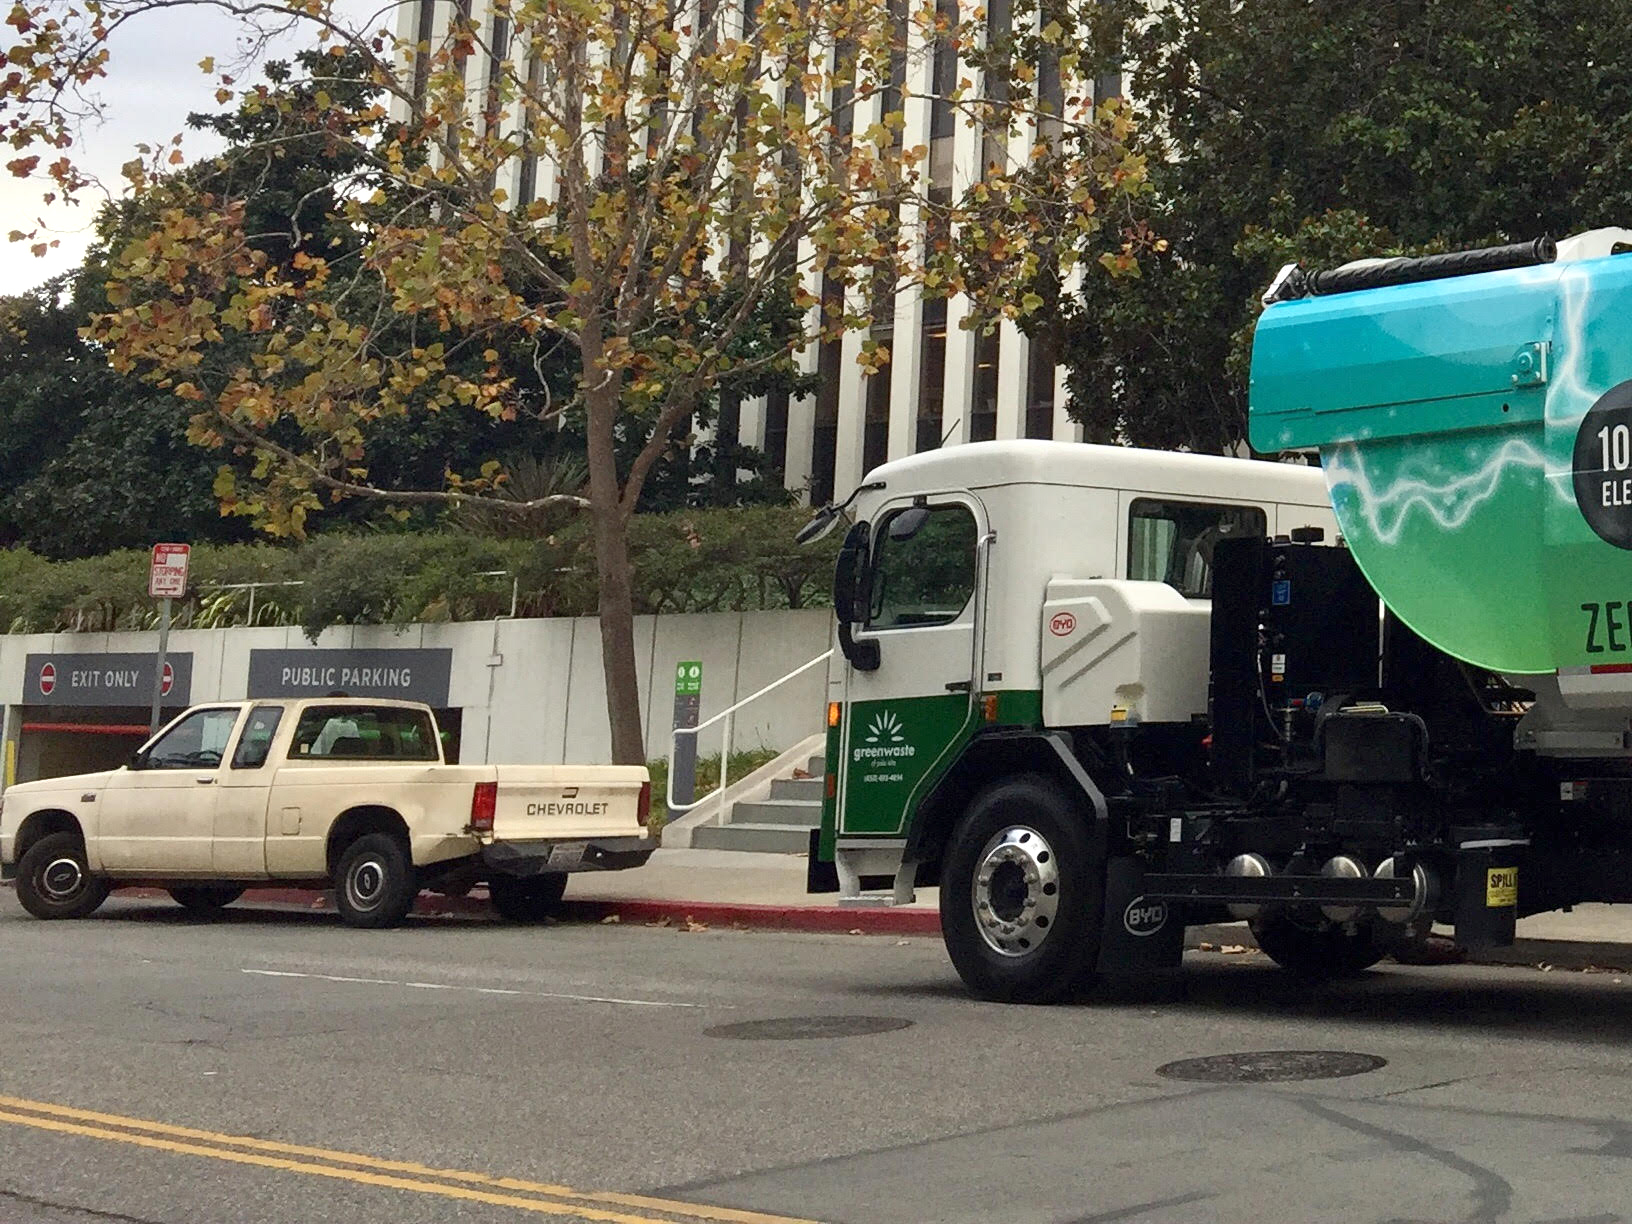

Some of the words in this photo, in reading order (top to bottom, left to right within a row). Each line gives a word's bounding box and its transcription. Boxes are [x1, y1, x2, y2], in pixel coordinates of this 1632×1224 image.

[1052, 618, 1073, 630] BYD
[71, 670, 101, 688] EXIT
[105, 670, 140, 688] ONLY
[281, 667, 336, 687] PUBLIC
[341, 668, 412, 687] PARKING
[853, 744, 916, 762] greenwaste
[526, 803, 609, 816] CHEVROLET
[1129, 906, 1163, 925] BYD
